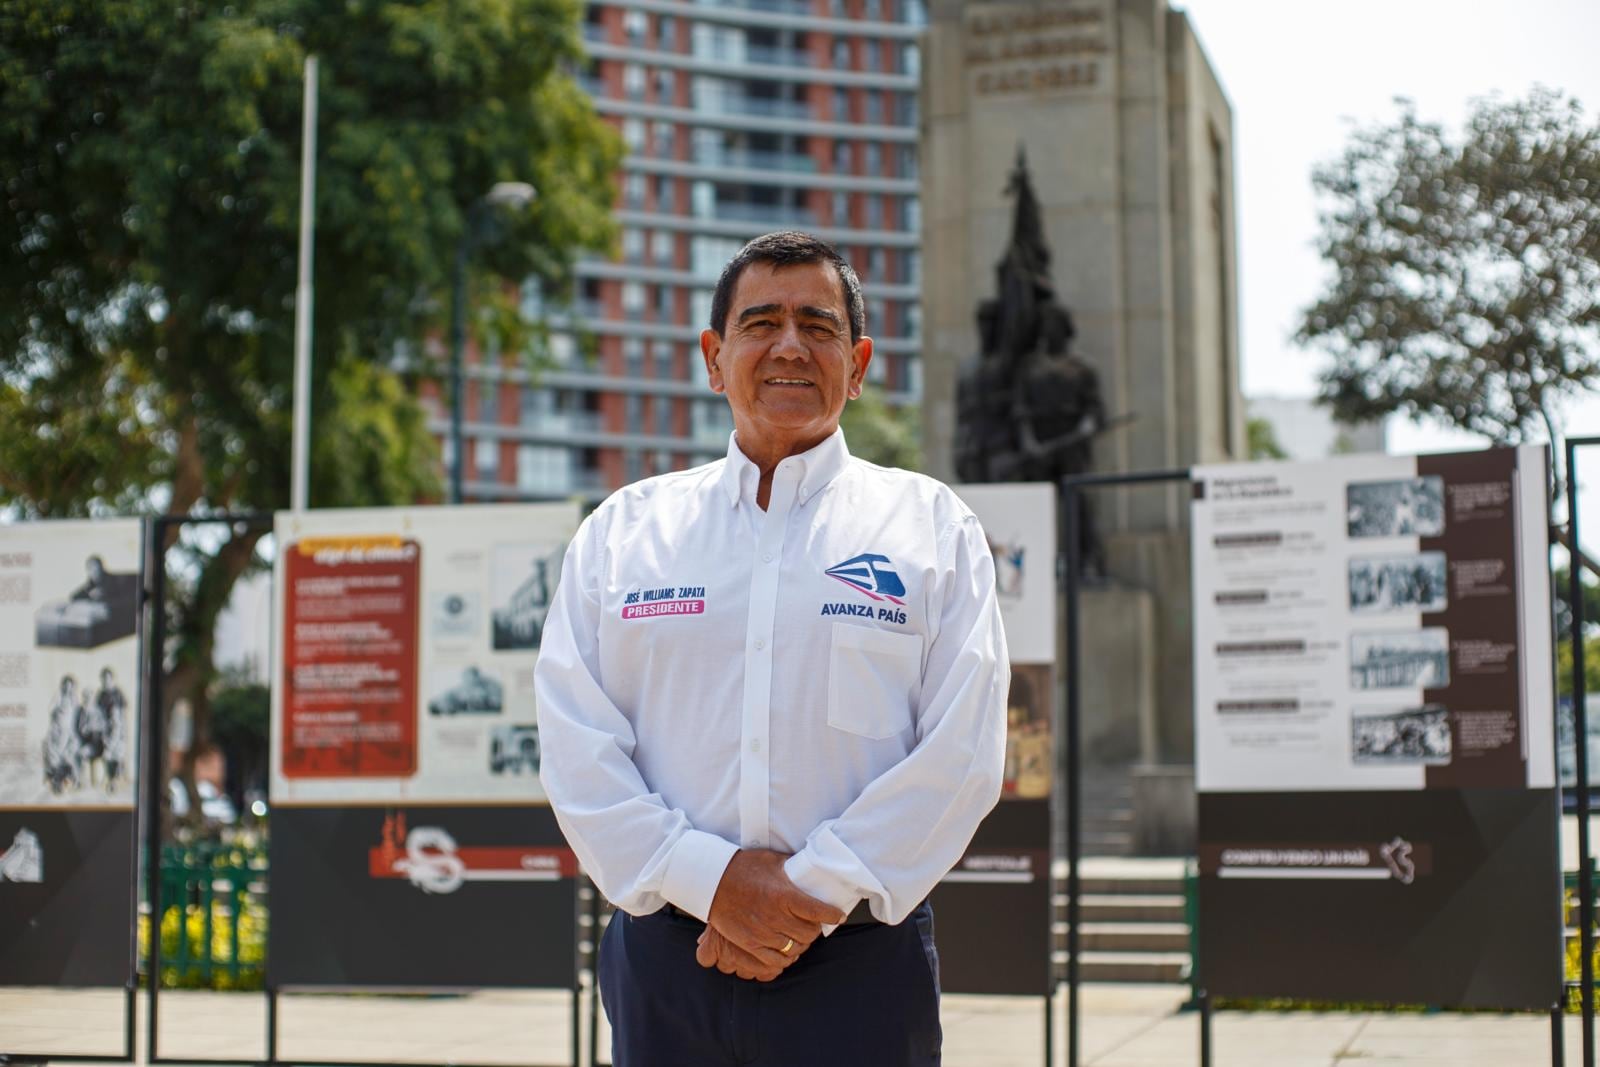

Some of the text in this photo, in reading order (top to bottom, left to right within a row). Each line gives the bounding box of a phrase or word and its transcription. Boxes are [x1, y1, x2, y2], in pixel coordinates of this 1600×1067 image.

[624, 586, 705, 604] JOSÉ WILLIAMS ZAPATA
[627, 601, 699, 618] PRESIDENTE
[821, 603, 907, 625] AVANZA PAÍS
